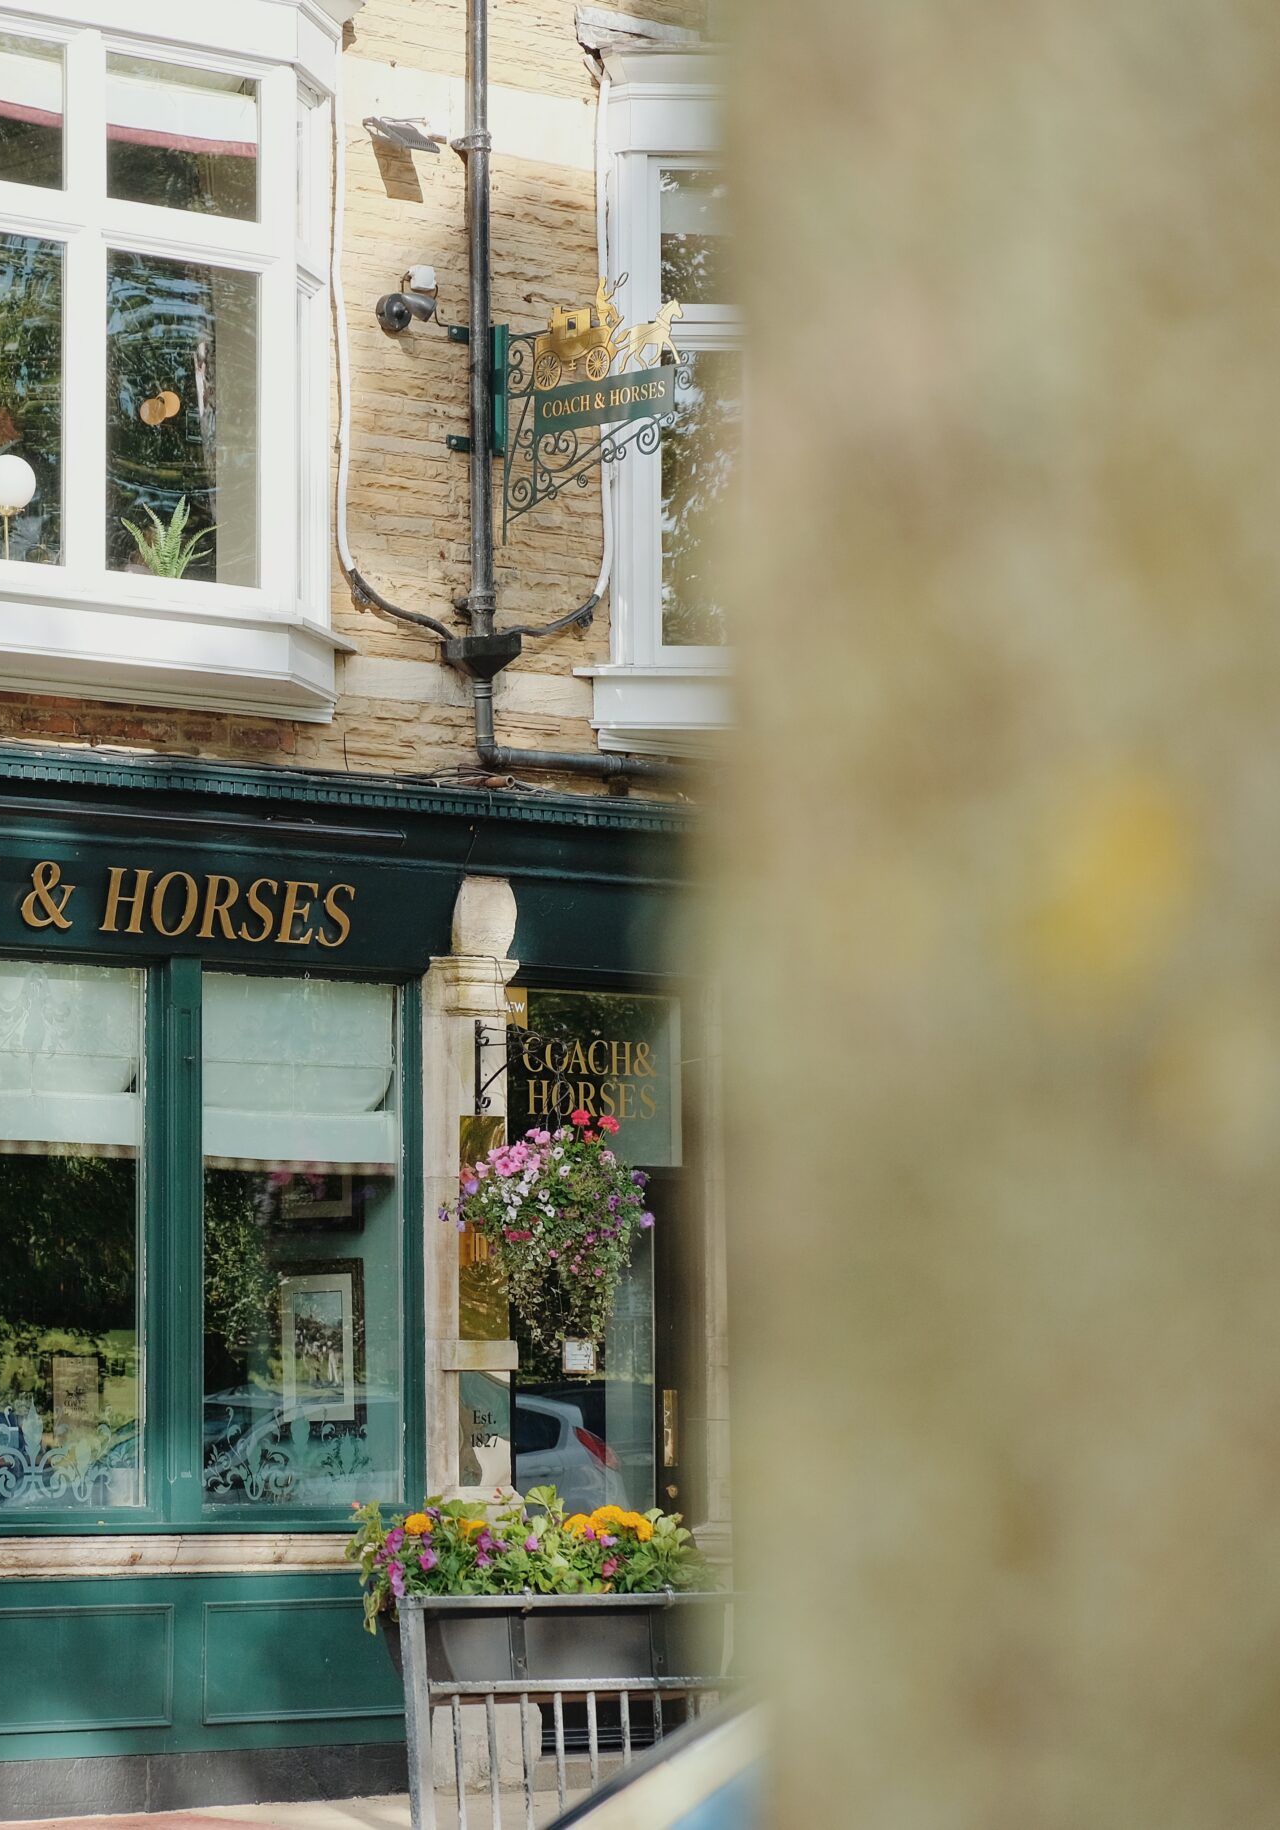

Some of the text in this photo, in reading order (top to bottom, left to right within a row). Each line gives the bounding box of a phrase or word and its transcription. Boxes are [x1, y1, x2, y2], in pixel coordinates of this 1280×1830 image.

[542, 380, 666, 418] COACH & HORSES
[20, 860, 76, 930] &
[98, 865, 356, 947] HORSES
[526, 1079, 658, 1121] HORSES
[472, 1409, 497, 1425] Est.
[471, 1433, 499, 1448] 1827
